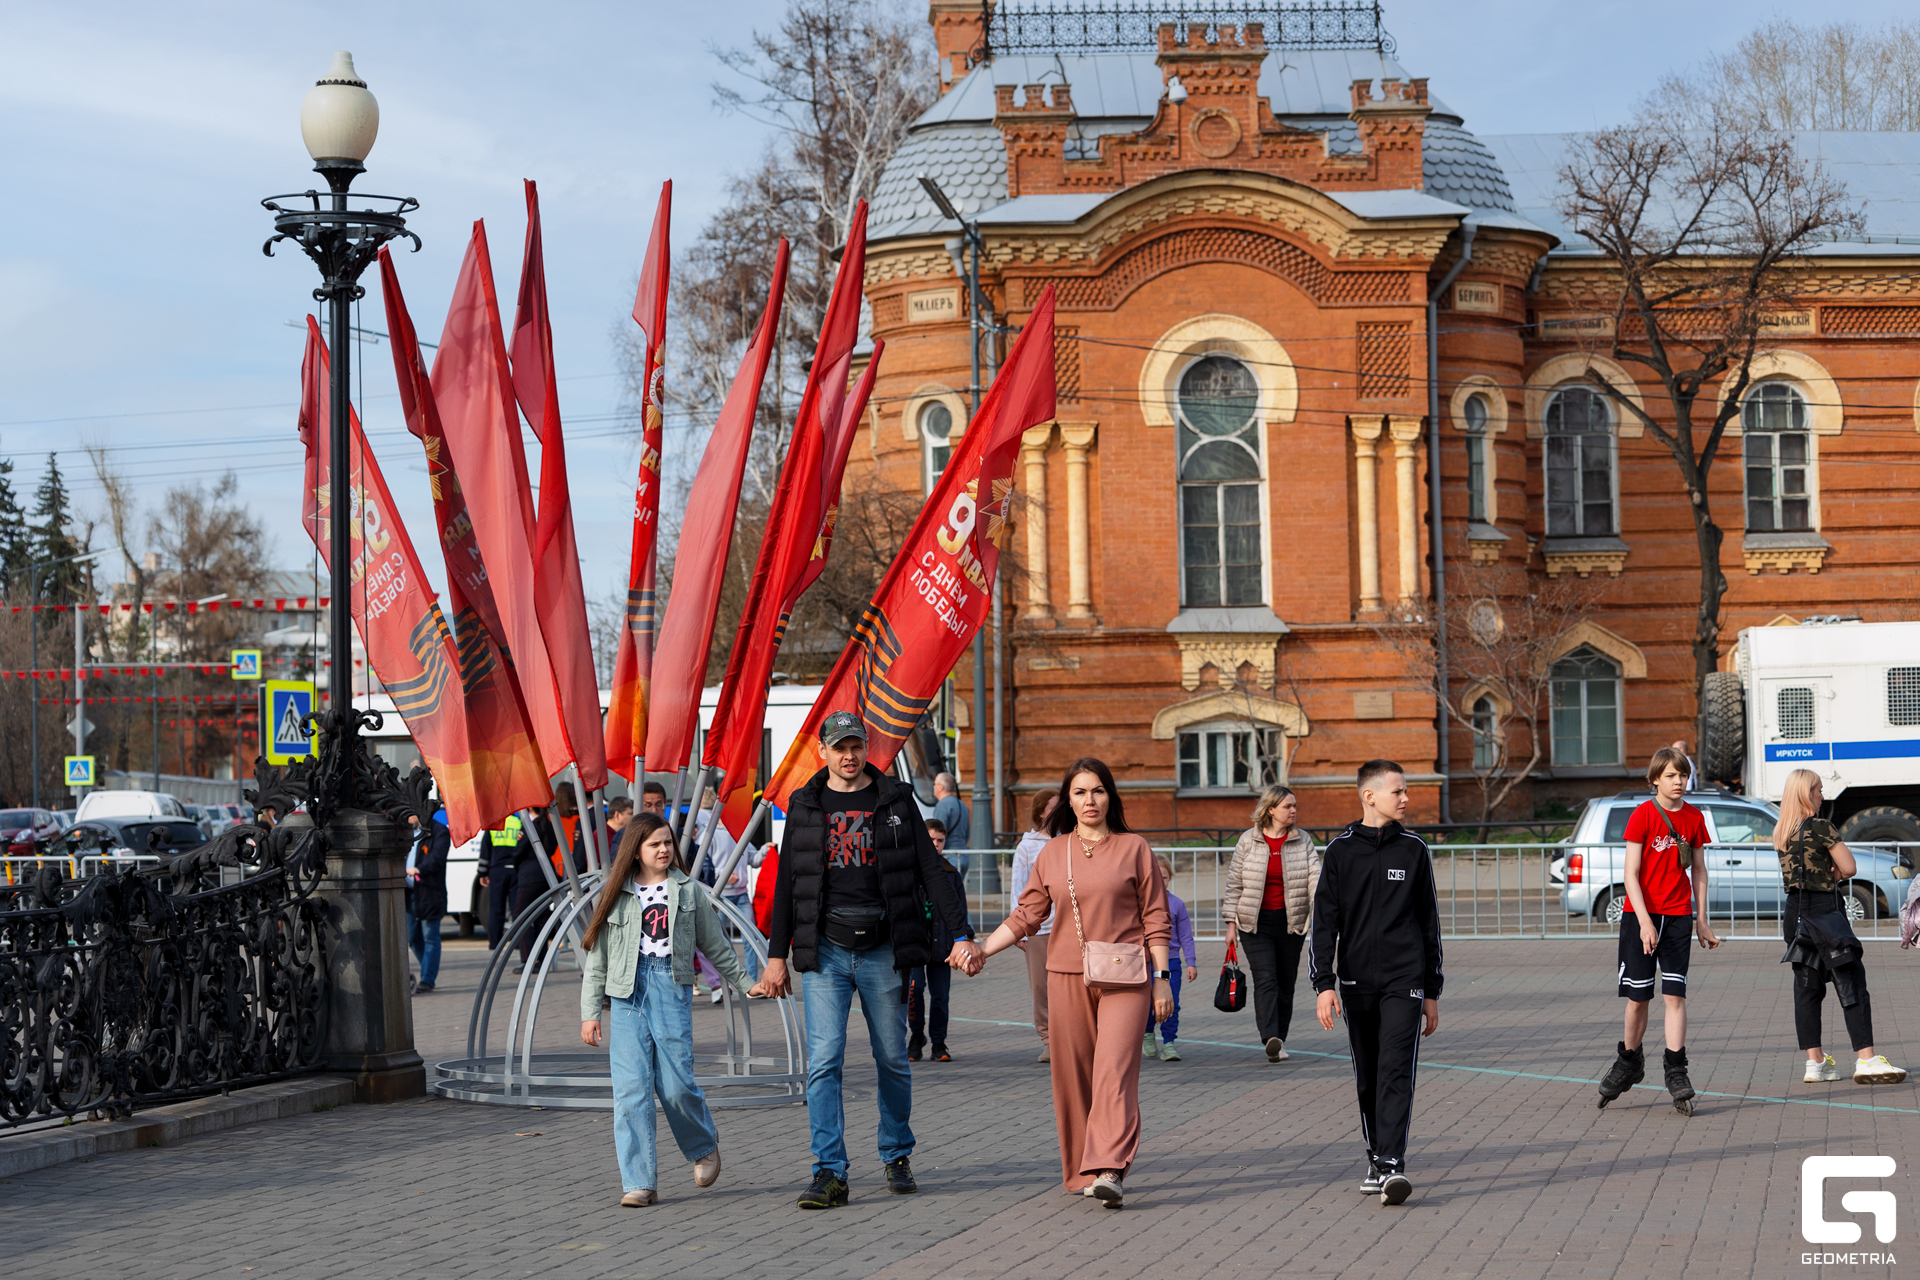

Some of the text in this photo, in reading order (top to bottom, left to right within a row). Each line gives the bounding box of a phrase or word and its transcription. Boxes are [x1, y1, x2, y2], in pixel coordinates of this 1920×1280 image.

[936, 492, 977, 555] 9
[910, 568, 968, 638] ПОБЕДЫ!
[922, 551, 968, 609] С ДНЁМ
[1775, 749, 1813, 758] ИРКУТСК
[1388, 870, 1404, 879] NS
